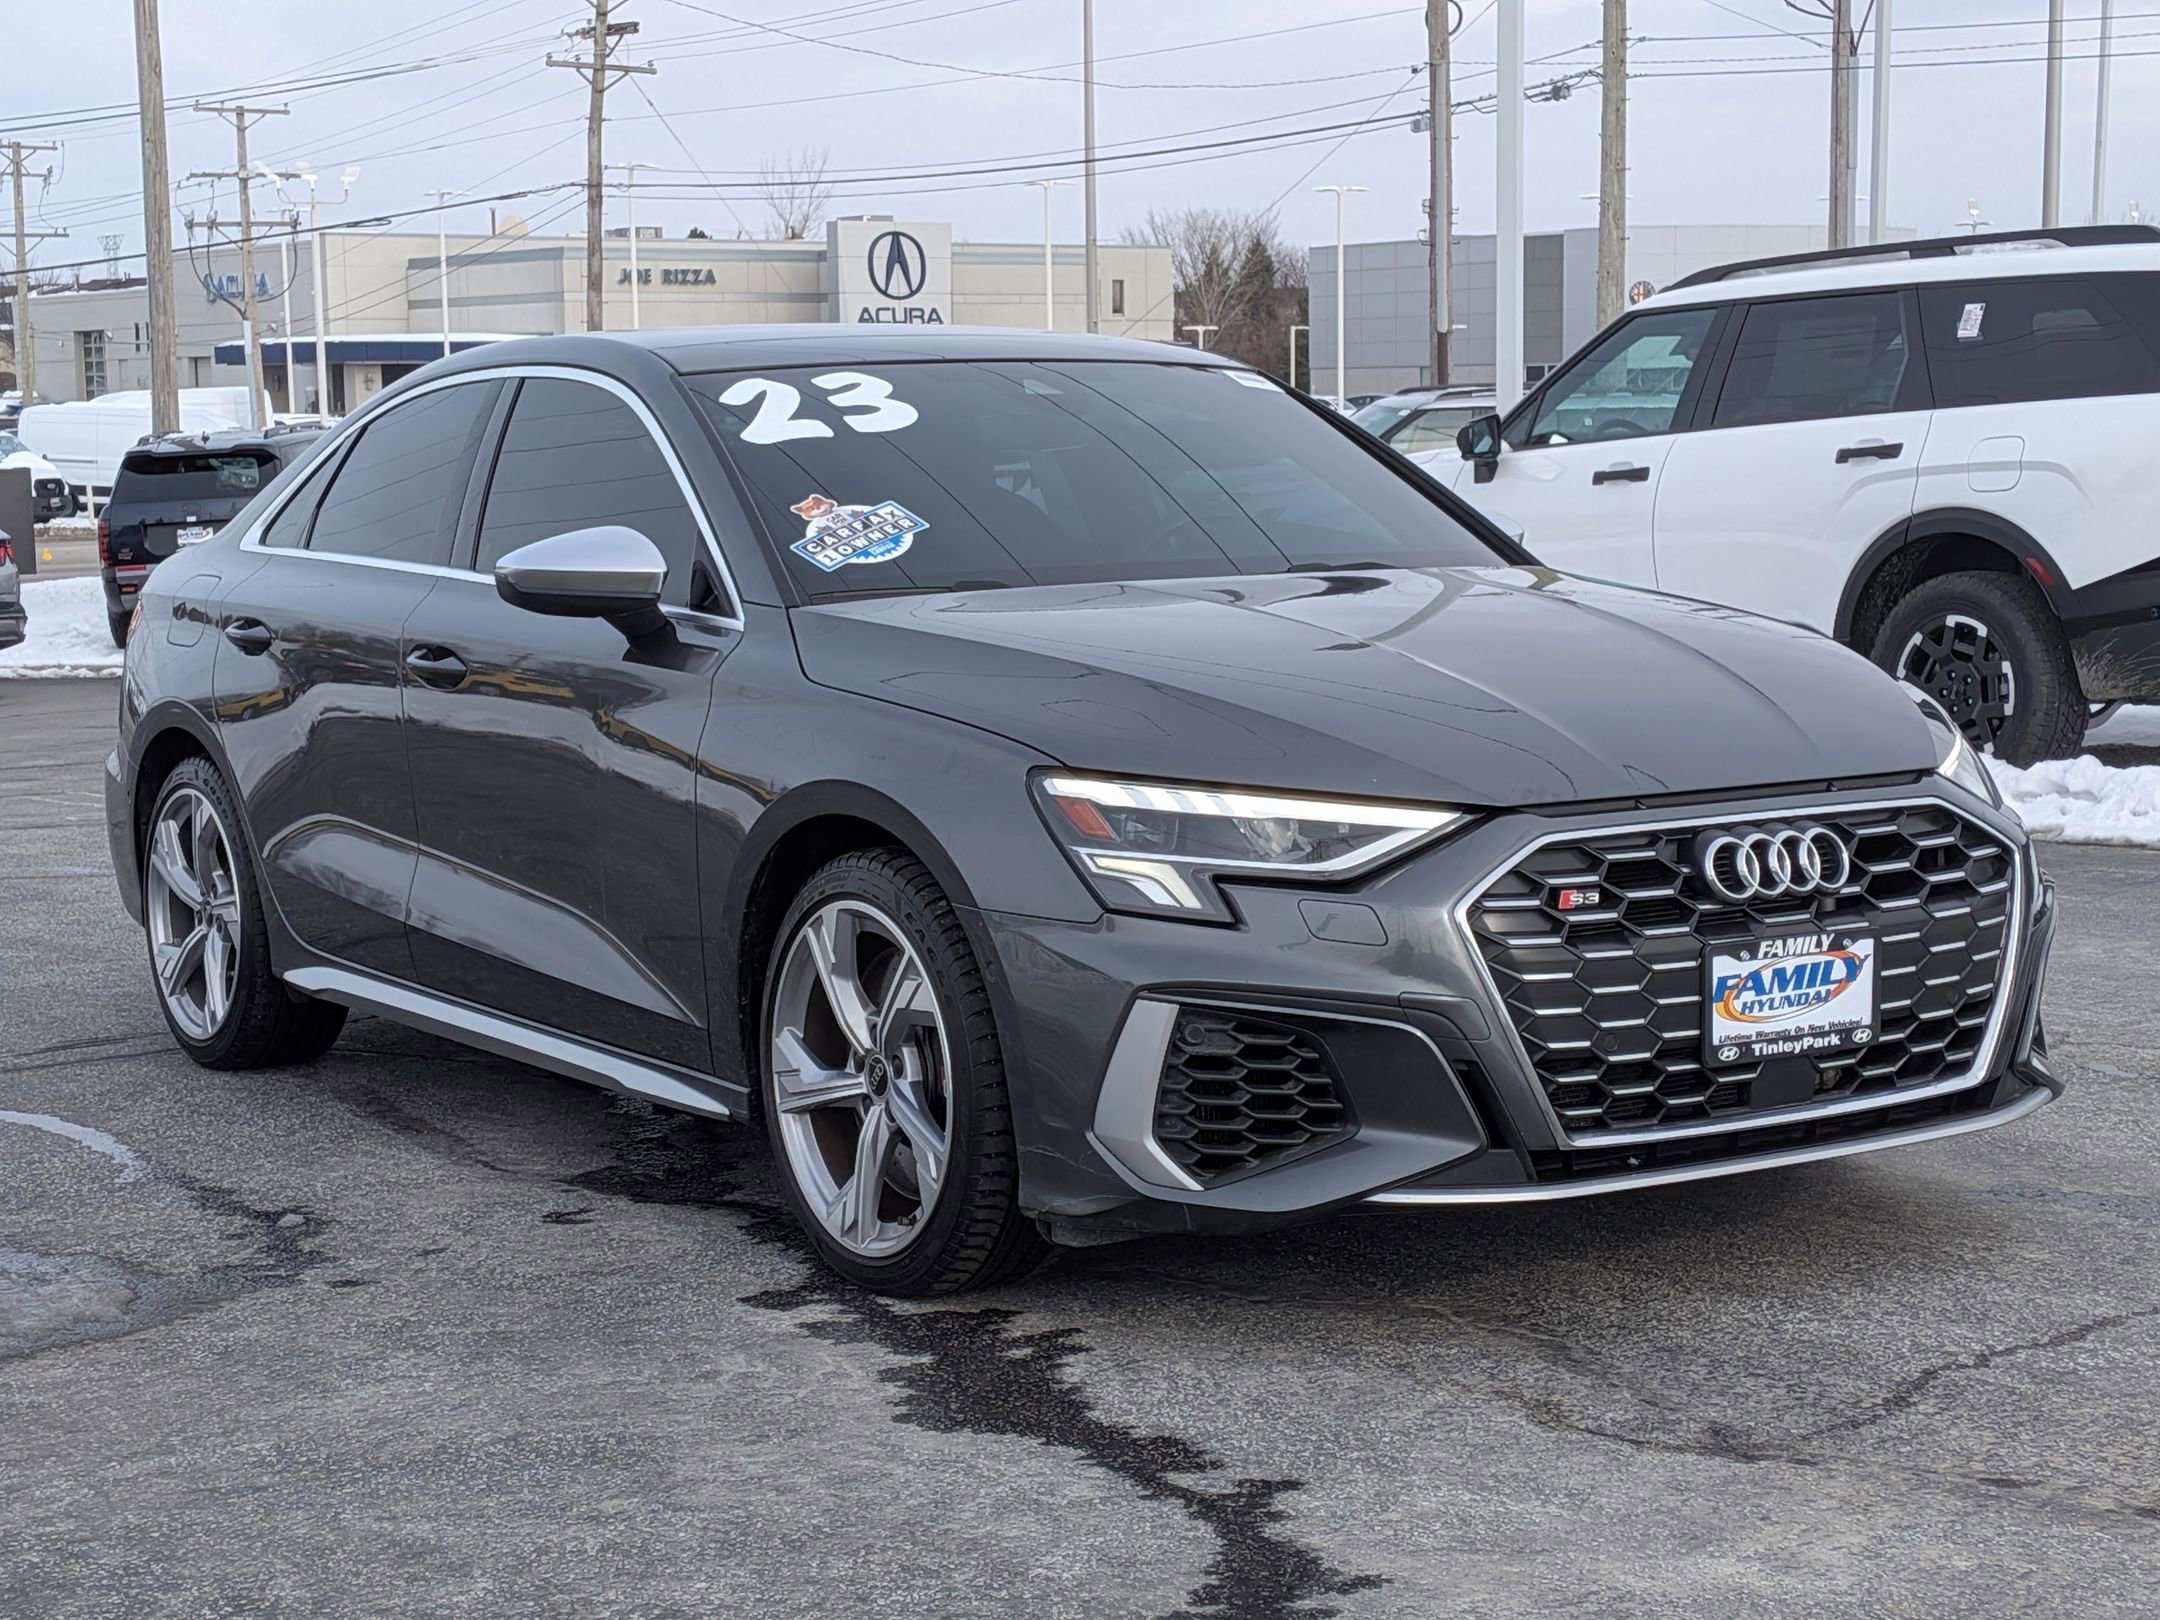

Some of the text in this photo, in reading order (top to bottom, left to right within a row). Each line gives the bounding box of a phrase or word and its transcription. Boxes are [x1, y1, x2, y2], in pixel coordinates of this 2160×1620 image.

[661, 267, 717, 285] RIZZA
[857, 306, 944, 325] ACURA
[718, 371, 919, 445] 23
[806, 509, 901, 553] CARFAX
[1568, 892, 1600, 905] S3
[1757, 933, 1835, 960] FAMILY
[1712, 953, 1872, 1003] FAMILY
[1739, 989, 1832, 1016] HYUNDAI
[1794, 1025, 1806, 1034] On
